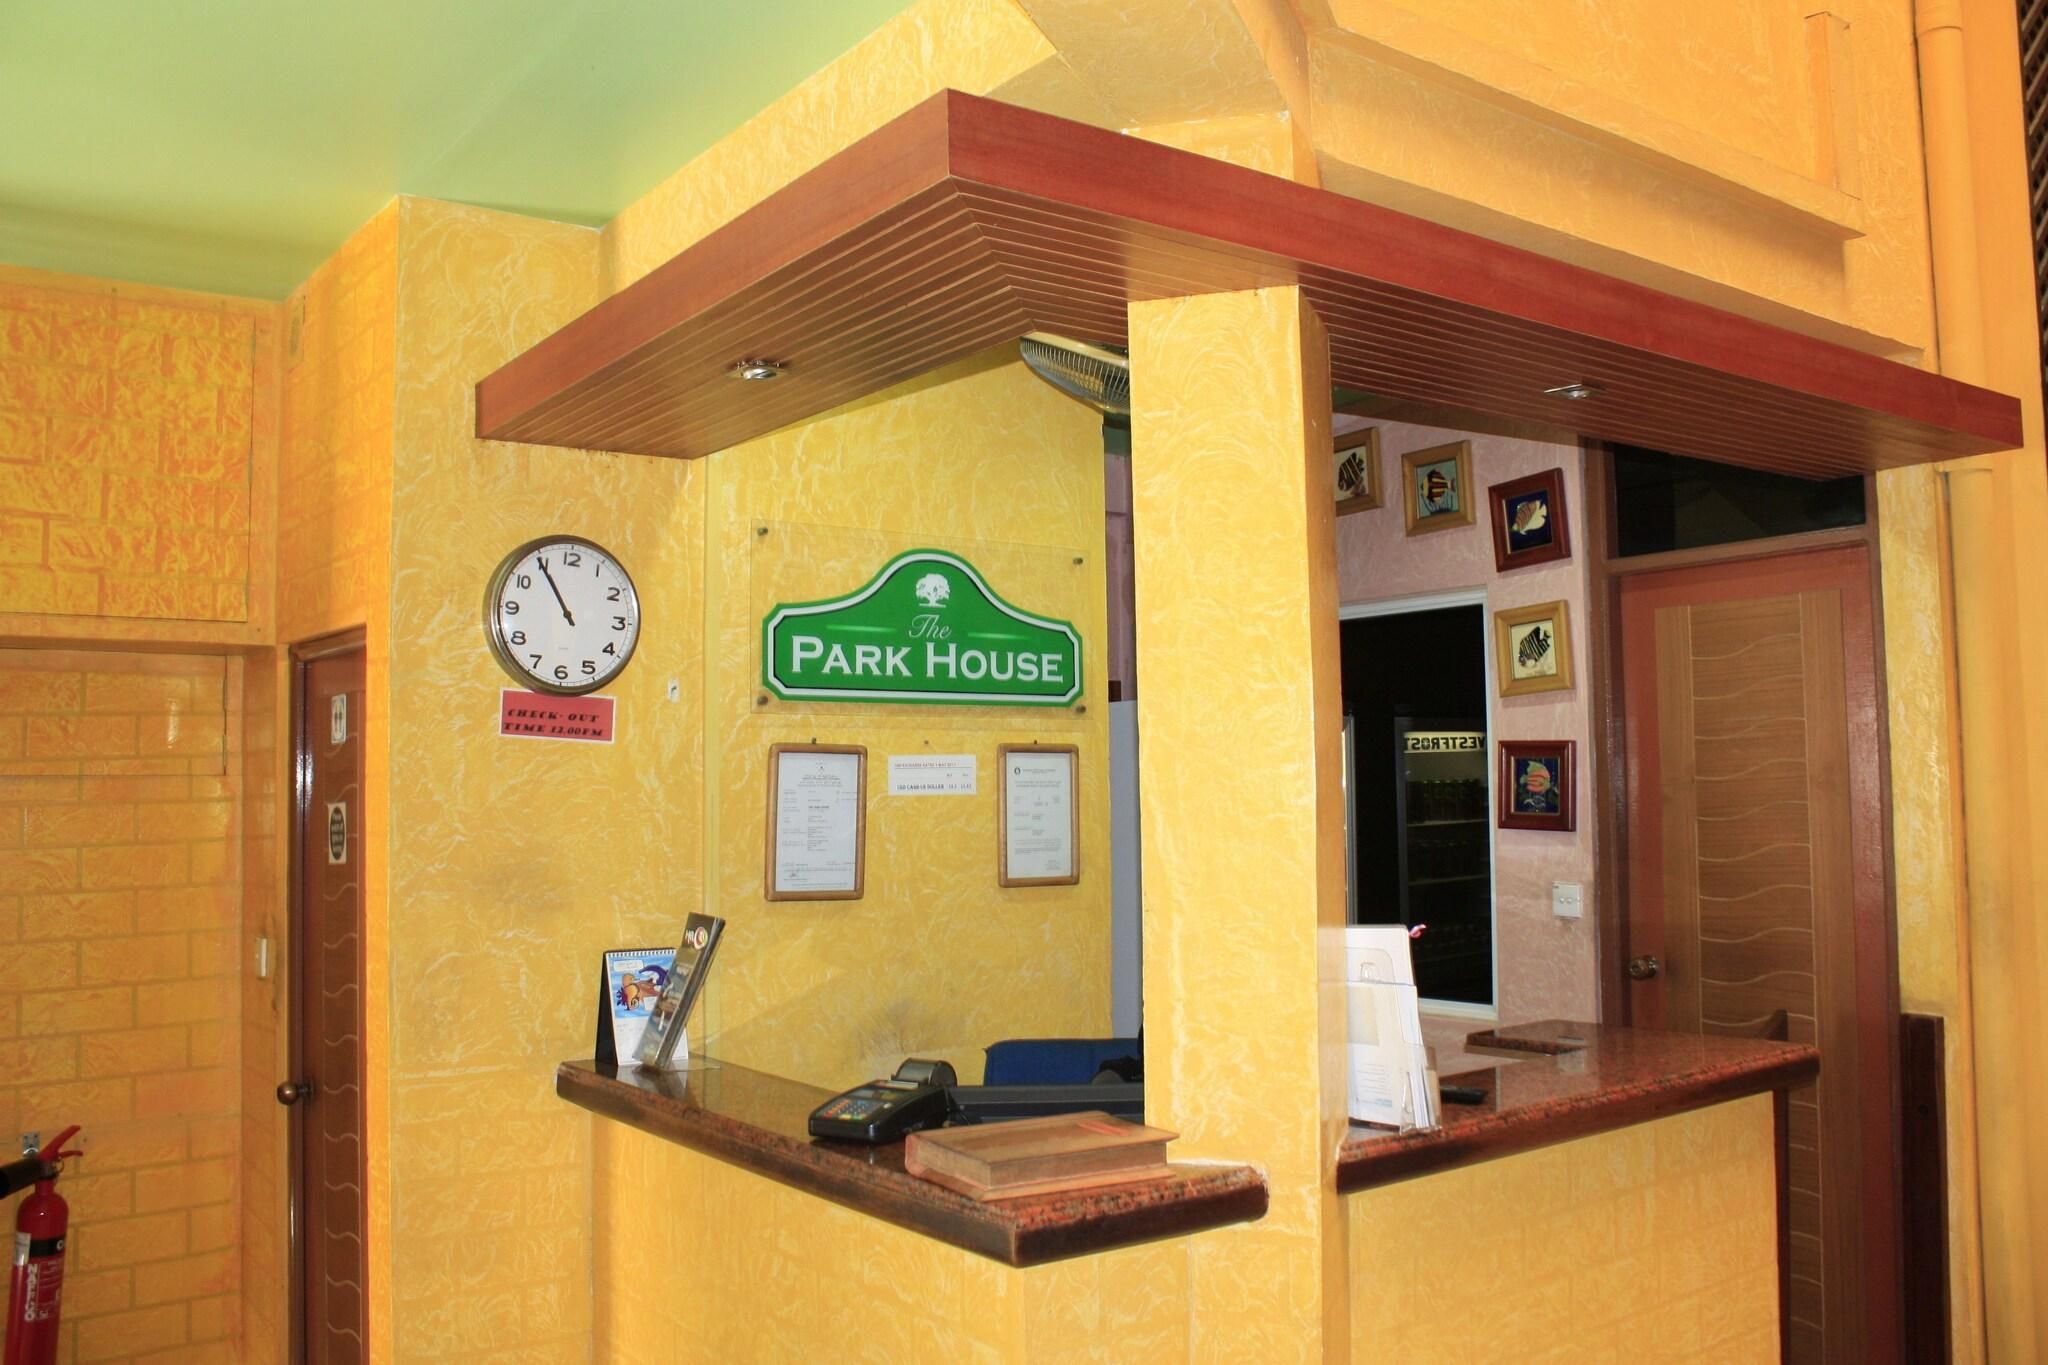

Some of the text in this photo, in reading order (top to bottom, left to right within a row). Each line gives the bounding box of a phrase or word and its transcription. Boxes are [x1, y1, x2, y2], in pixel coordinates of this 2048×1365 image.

[563, 551, 581, 567] 12
[516, 574, 532, 590] 10
[607, 587, 620, 601] 2
[505, 601, 519, 615] 9
[611, 616, 626, 630] 3
[908, 614, 951, 640] The
[510, 631, 526, 645] 8
[602, 642, 616, 656] 4
[529, 653, 542, 669] 7
[791, 634, 1064, 683] PARK HOUSE
[554, 665, 568, 679] 6
[581, 660, 596, 675] 5
[567, 712, 600, 723] OUT
[504, 722, 545, 733] TIME
